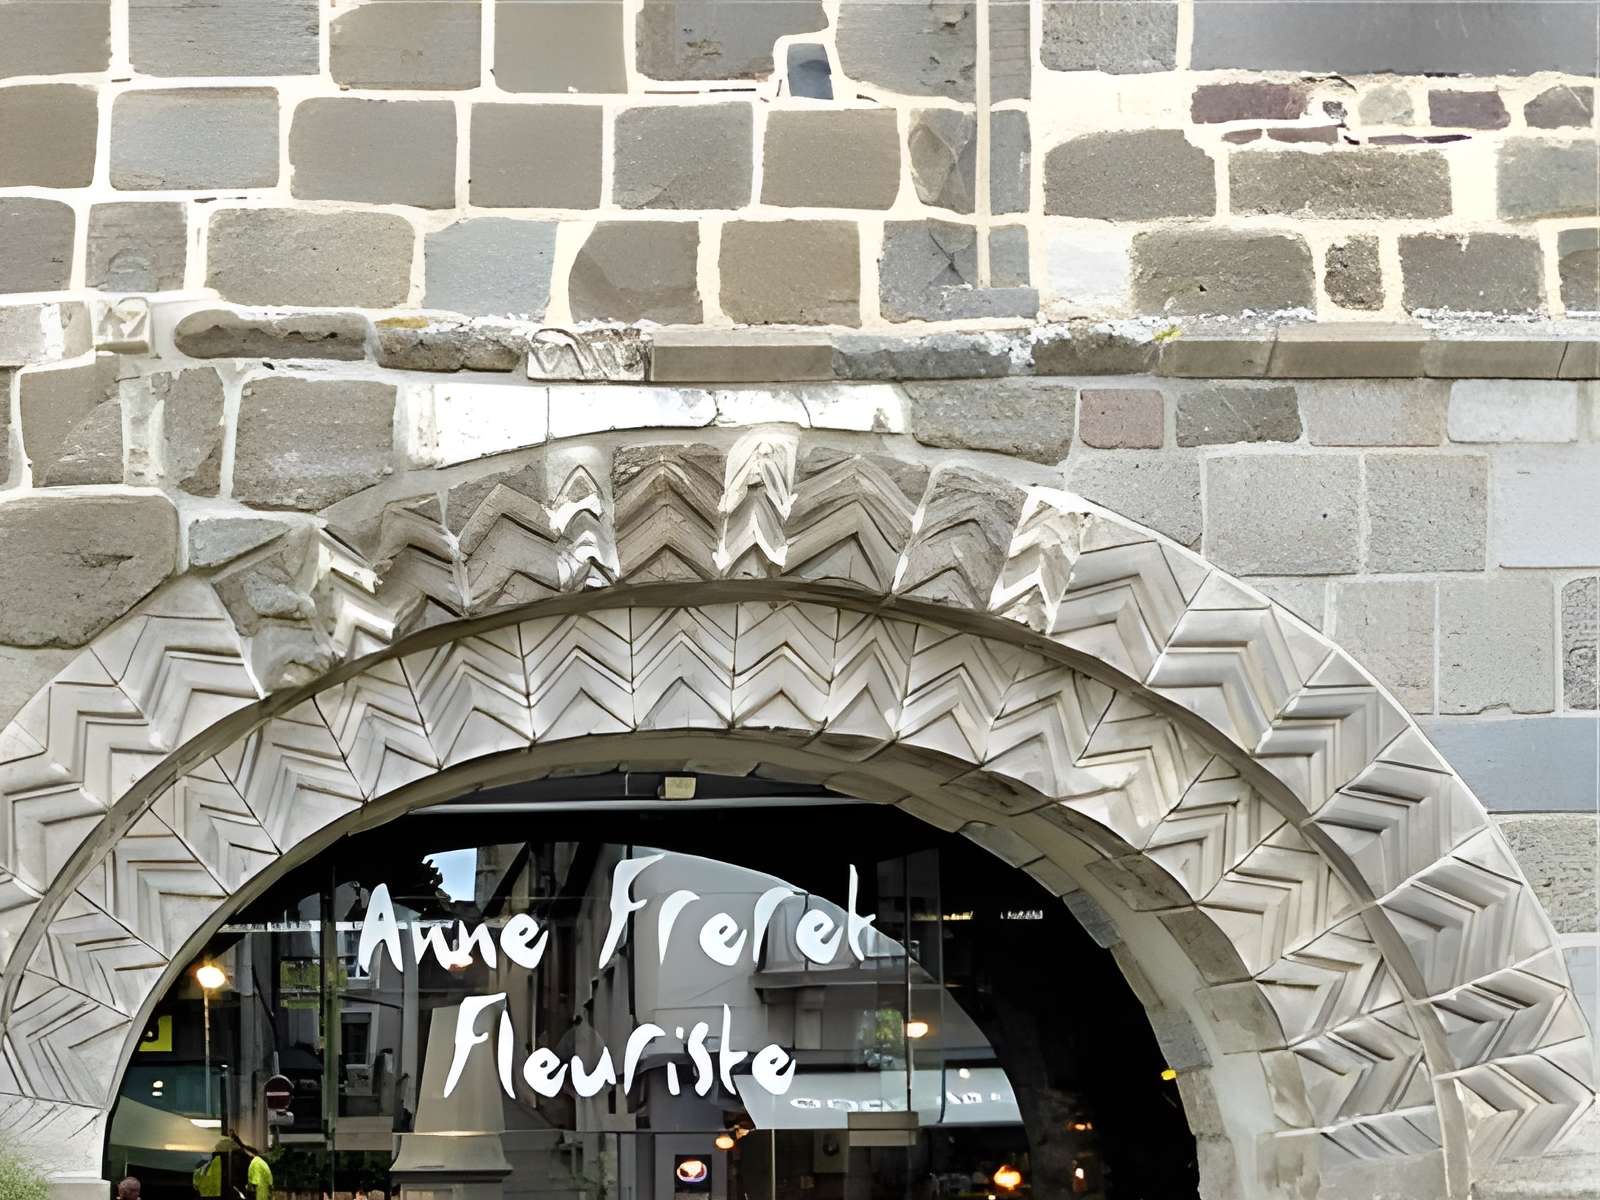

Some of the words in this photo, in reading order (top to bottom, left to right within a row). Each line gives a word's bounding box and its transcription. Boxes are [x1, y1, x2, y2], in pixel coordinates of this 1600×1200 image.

[357, 883, 549, 975] Anne
[598, 852, 878, 971] Freret
[443, 991, 798, 1100] Fleuriste
